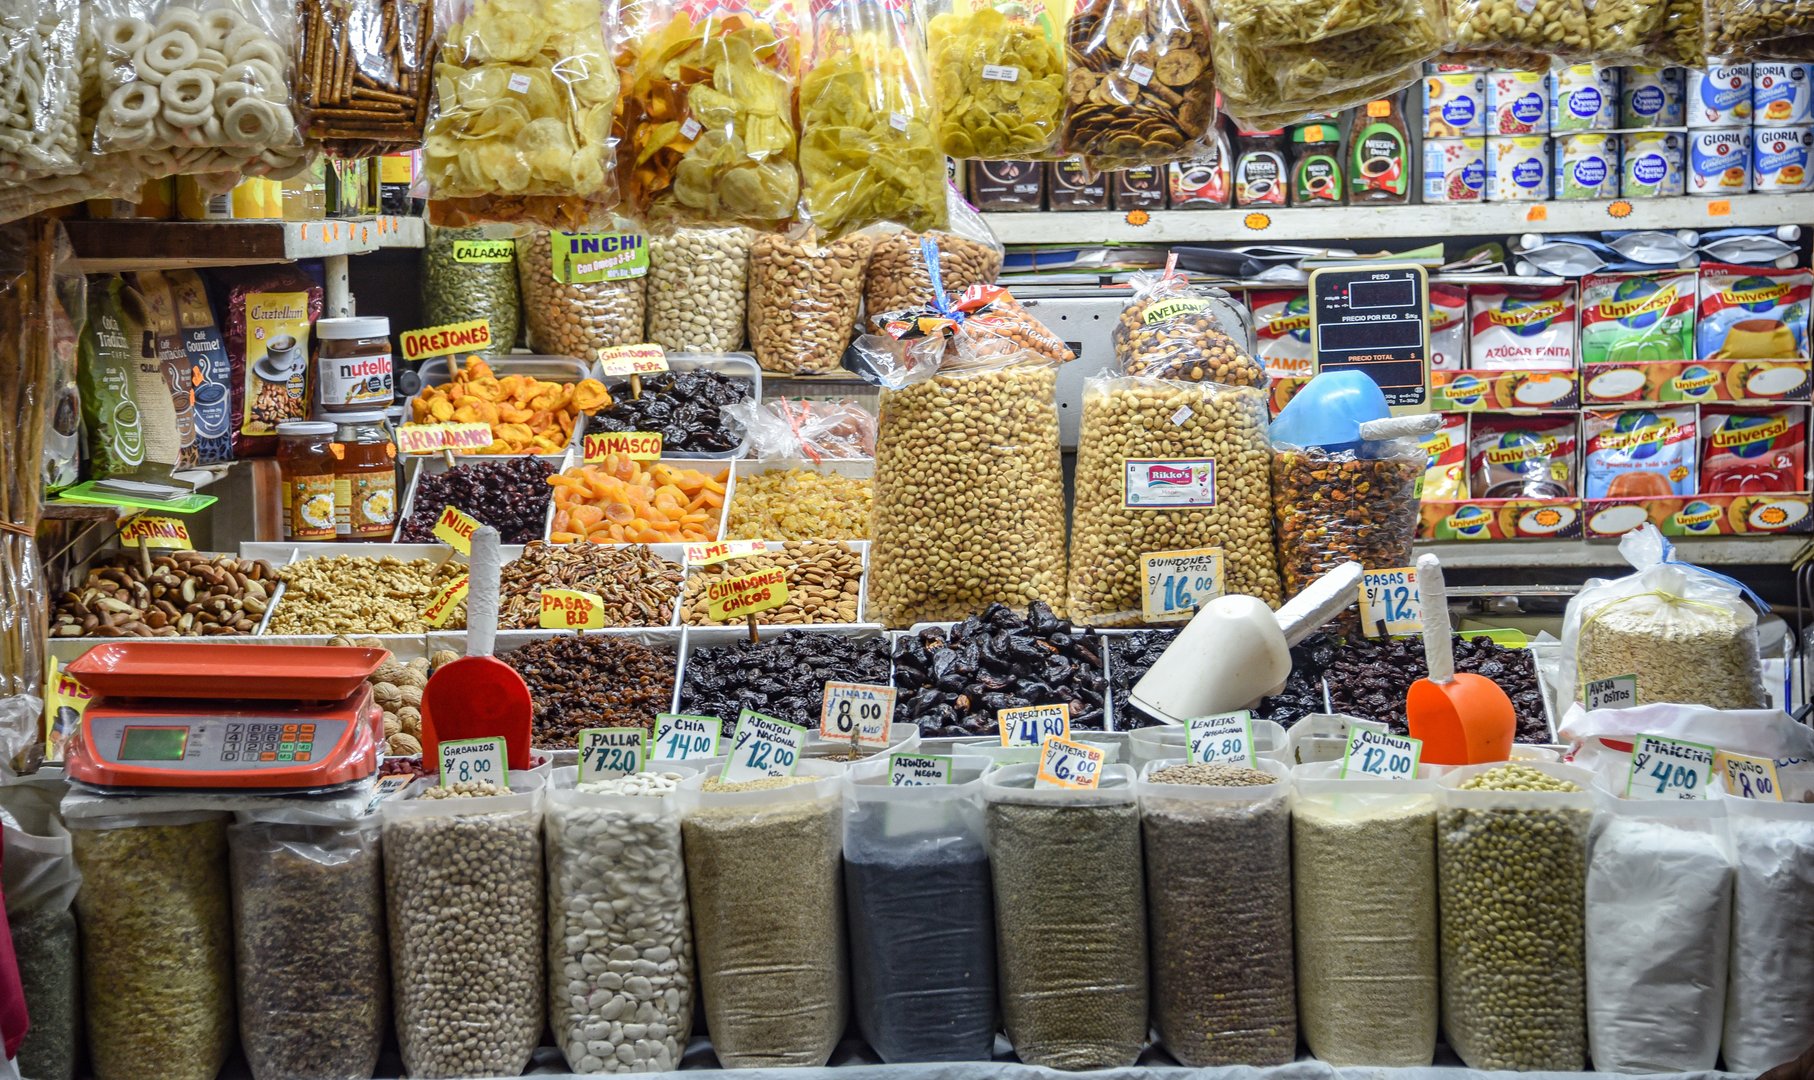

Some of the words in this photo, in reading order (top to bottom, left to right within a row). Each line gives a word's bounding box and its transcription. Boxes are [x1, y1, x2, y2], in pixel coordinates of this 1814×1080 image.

[1754, 66, 1786, 78] GLORIA
[1704, 134, 1741, 146] GLORIA
[1762, 132, 1799, 144] GLORIA
[1576, 168, 1604, 176] Crema
[1635, 165, 1664, 174] Crema
[570, 235, 642, 253] INCHI
[457, 248, 514, 258] CALABAZA
[577, 264, 593, 274] Con
[1704, 268, 1728, 277] Flan
[1725, 286, 1789, 303] Universal
[1601, 291, 1677, 316] Universal
[1490, 302, 1564, 324] Universal
[194, 331, 205, 340] Café
[406, 326, 489, 357] OREJONES
[186, 338, 220, 352] Gourmet
[1486, 345, 1531, 358] AZÚCAR
[601, 349, 664, 362] GUINDONES
[634, 361, 663, 372] PEPA
[1675, 375, 1718, 389] Universal
[1445, 386, 1488, 398] Universal
[401, 428, 492, 451] ARANDANOS
[1714, 421, 1787, 446] Universal
[585, 436, 660, 460] DAMASCO
[1489, 439, 1556, 463] Univeral
[1778, 456, 1792, 468] 2L
[1450, 514, 1491, 527] Universal
[1676, 511, 1720, 524] Universal
[119, 519, 188, 540] CASTAÑAS
[1149, 555, 1212, 568] GUINDONES
[709, 570, 784, 600] GUINDONES
[1364, 572, 1404, 586] PASAS
[543, 594, 592, 612] PASAS
[722, 588, 771, 612] CHICOS
[834, 688, 875, 700] LINAZA
[1589, 680, 1615, 696] AVENA
[1593, 697, 1599, 708] 3
[1604, 690, 1630, 704] OSITOS
[674, 719, 705, 733] CHÍA
[1191, 716, 1236, 729] LENTEJAS
[590, 733, 642, 747] PALLAR
[756, 730, 796, 748] NACIONAL
[1362, 730, 1411, 751] QUINUA
[443, 743, 494, 756] GARBANZOS
[666, 734, 710, 760] 14.00
[1048, 739, 1087, 759] LENTEJAS
[1088, 751, 1100, 761] BB
[1203, 738, 1242, 763] 6.80
[1644, 738, 1713, 765] MAICENA
[595, 748, 636, 772] 7.20
[746, 740, 794, 770] 12.00
[1362, 747, 1410, 774] 12.00
[459, 759, 490, 782] 8.00
[914, 769, 942, 778] NEGRO
[1728, 760, 1763, 774] CHUÑO
[1651, 760, 1698, 793] 4.00
